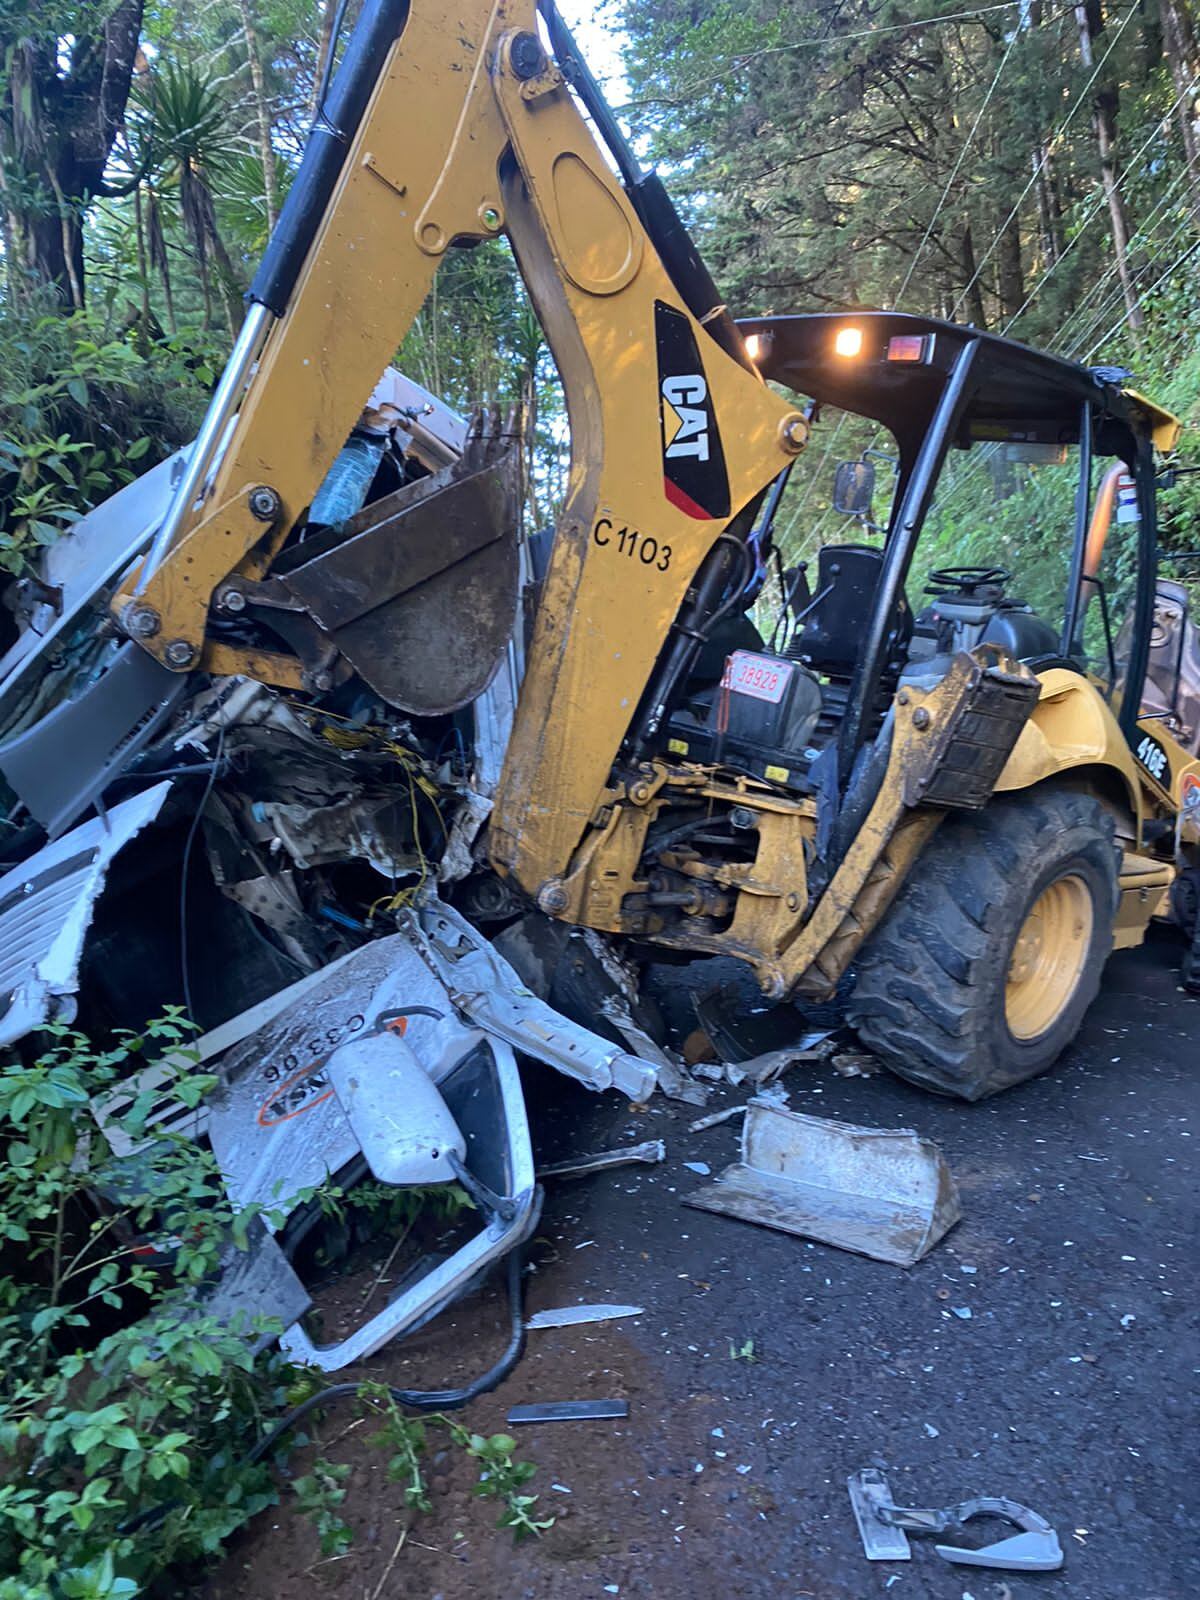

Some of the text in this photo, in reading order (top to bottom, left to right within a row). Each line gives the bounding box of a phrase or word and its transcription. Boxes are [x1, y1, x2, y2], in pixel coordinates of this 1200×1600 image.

[662, 374, 710, 462] CAT
[736, 664, 779, 692] 38928
[1136, 736, 1167, 779] 416E
